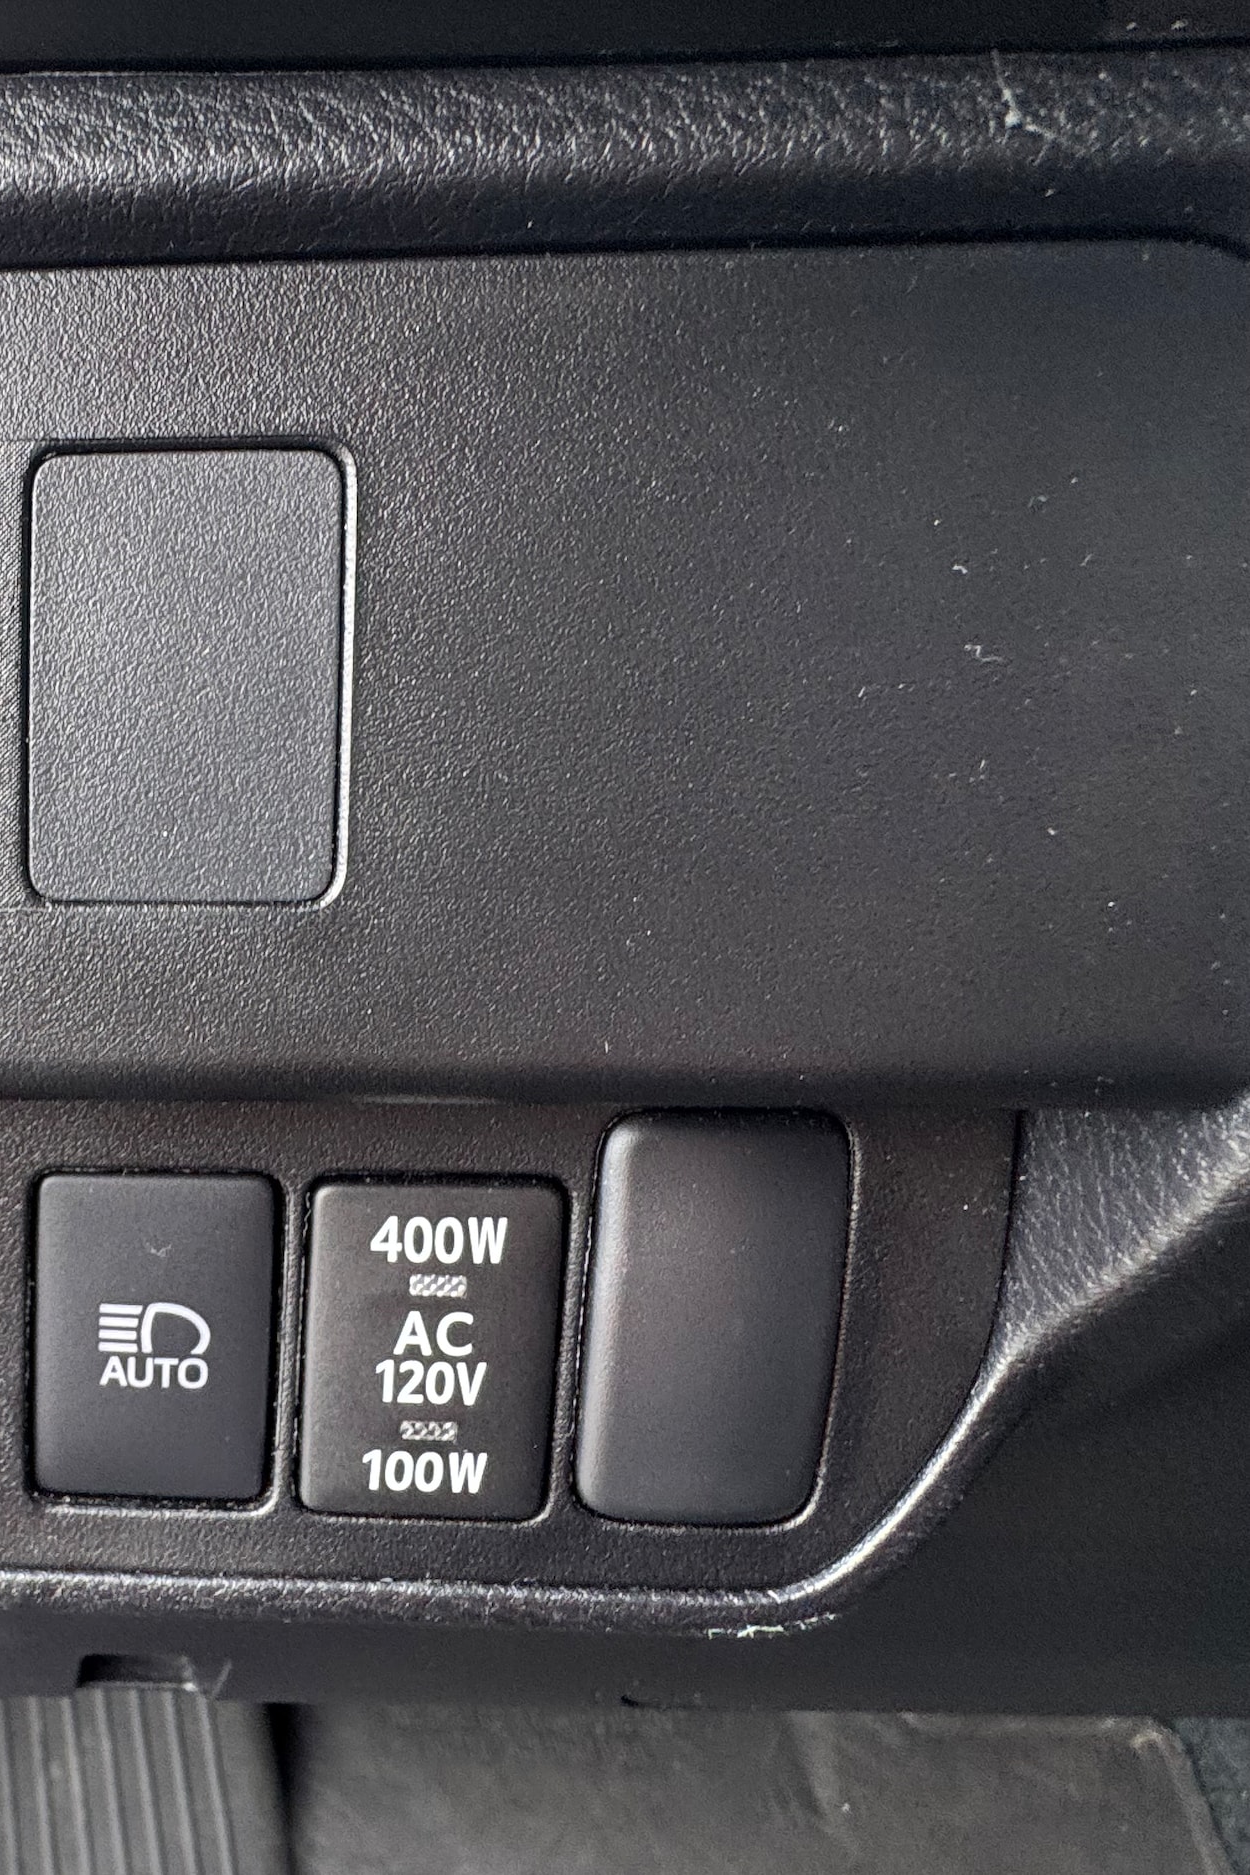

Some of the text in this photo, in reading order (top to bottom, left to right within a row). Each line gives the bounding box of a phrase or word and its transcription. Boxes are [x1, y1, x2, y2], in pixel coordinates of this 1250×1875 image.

[370, 1216, 508, 1264] 400W
[393, 1311, 474, 1356] AC
[99, 1356, 209, 1389] AUTO
[375, 1359, 487, 1406] 120V
[362, 1449, 488, 1494] 100W
